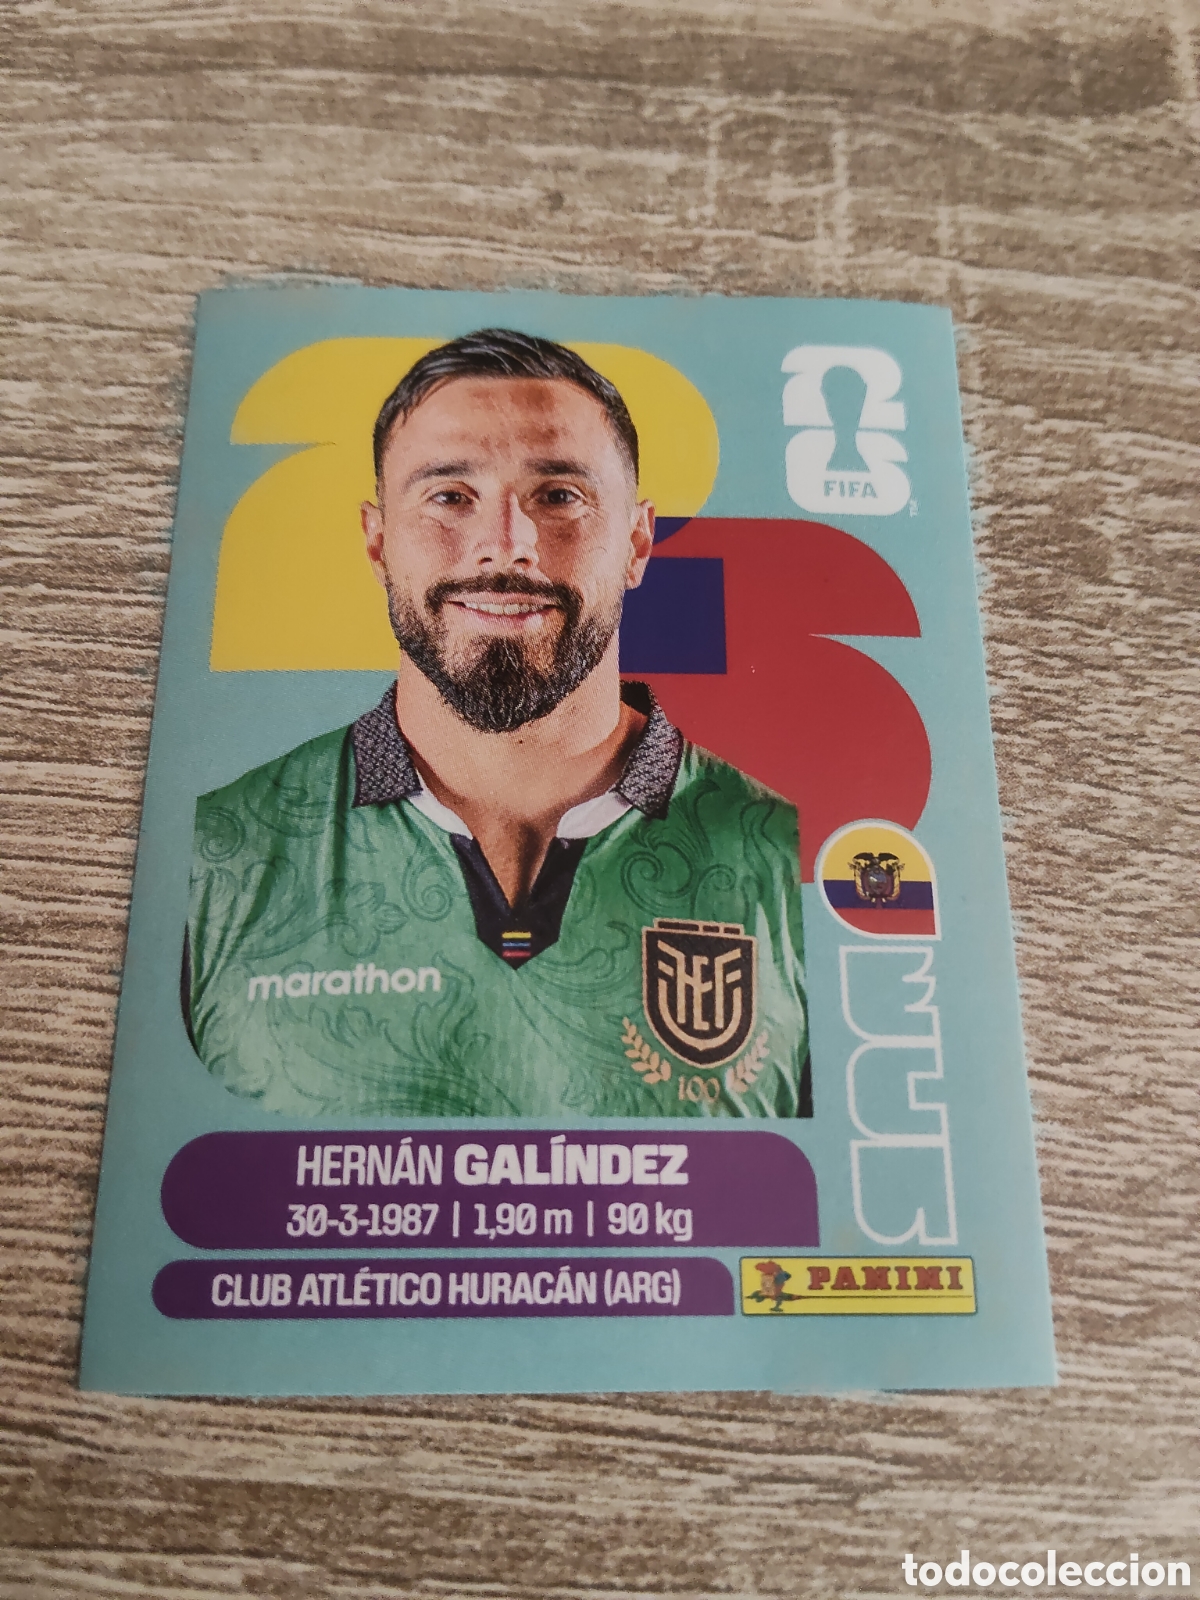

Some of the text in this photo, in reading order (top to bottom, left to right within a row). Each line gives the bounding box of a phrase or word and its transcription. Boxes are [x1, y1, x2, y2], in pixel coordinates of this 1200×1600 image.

[823, 480, 878, 498] FIFA
[248, 962, 442, 1001] marathon
[296, 1134, 689, 1187] HERNÁN GALÍNDEZ
[286, 1203, 440, 1237] 30-3-1987
[473, 1202, 538, 1240] 1,90
[543, 1208, 574, 1235] m
[607, 1202, 649, 1236] 90
[655, 1201, 693, 1242] kg
[211, 1265, 682, 1308] CLUB ATLÉTICO HURACÁN (ARG)
[806, 1266, 964, 1291] PANINI
